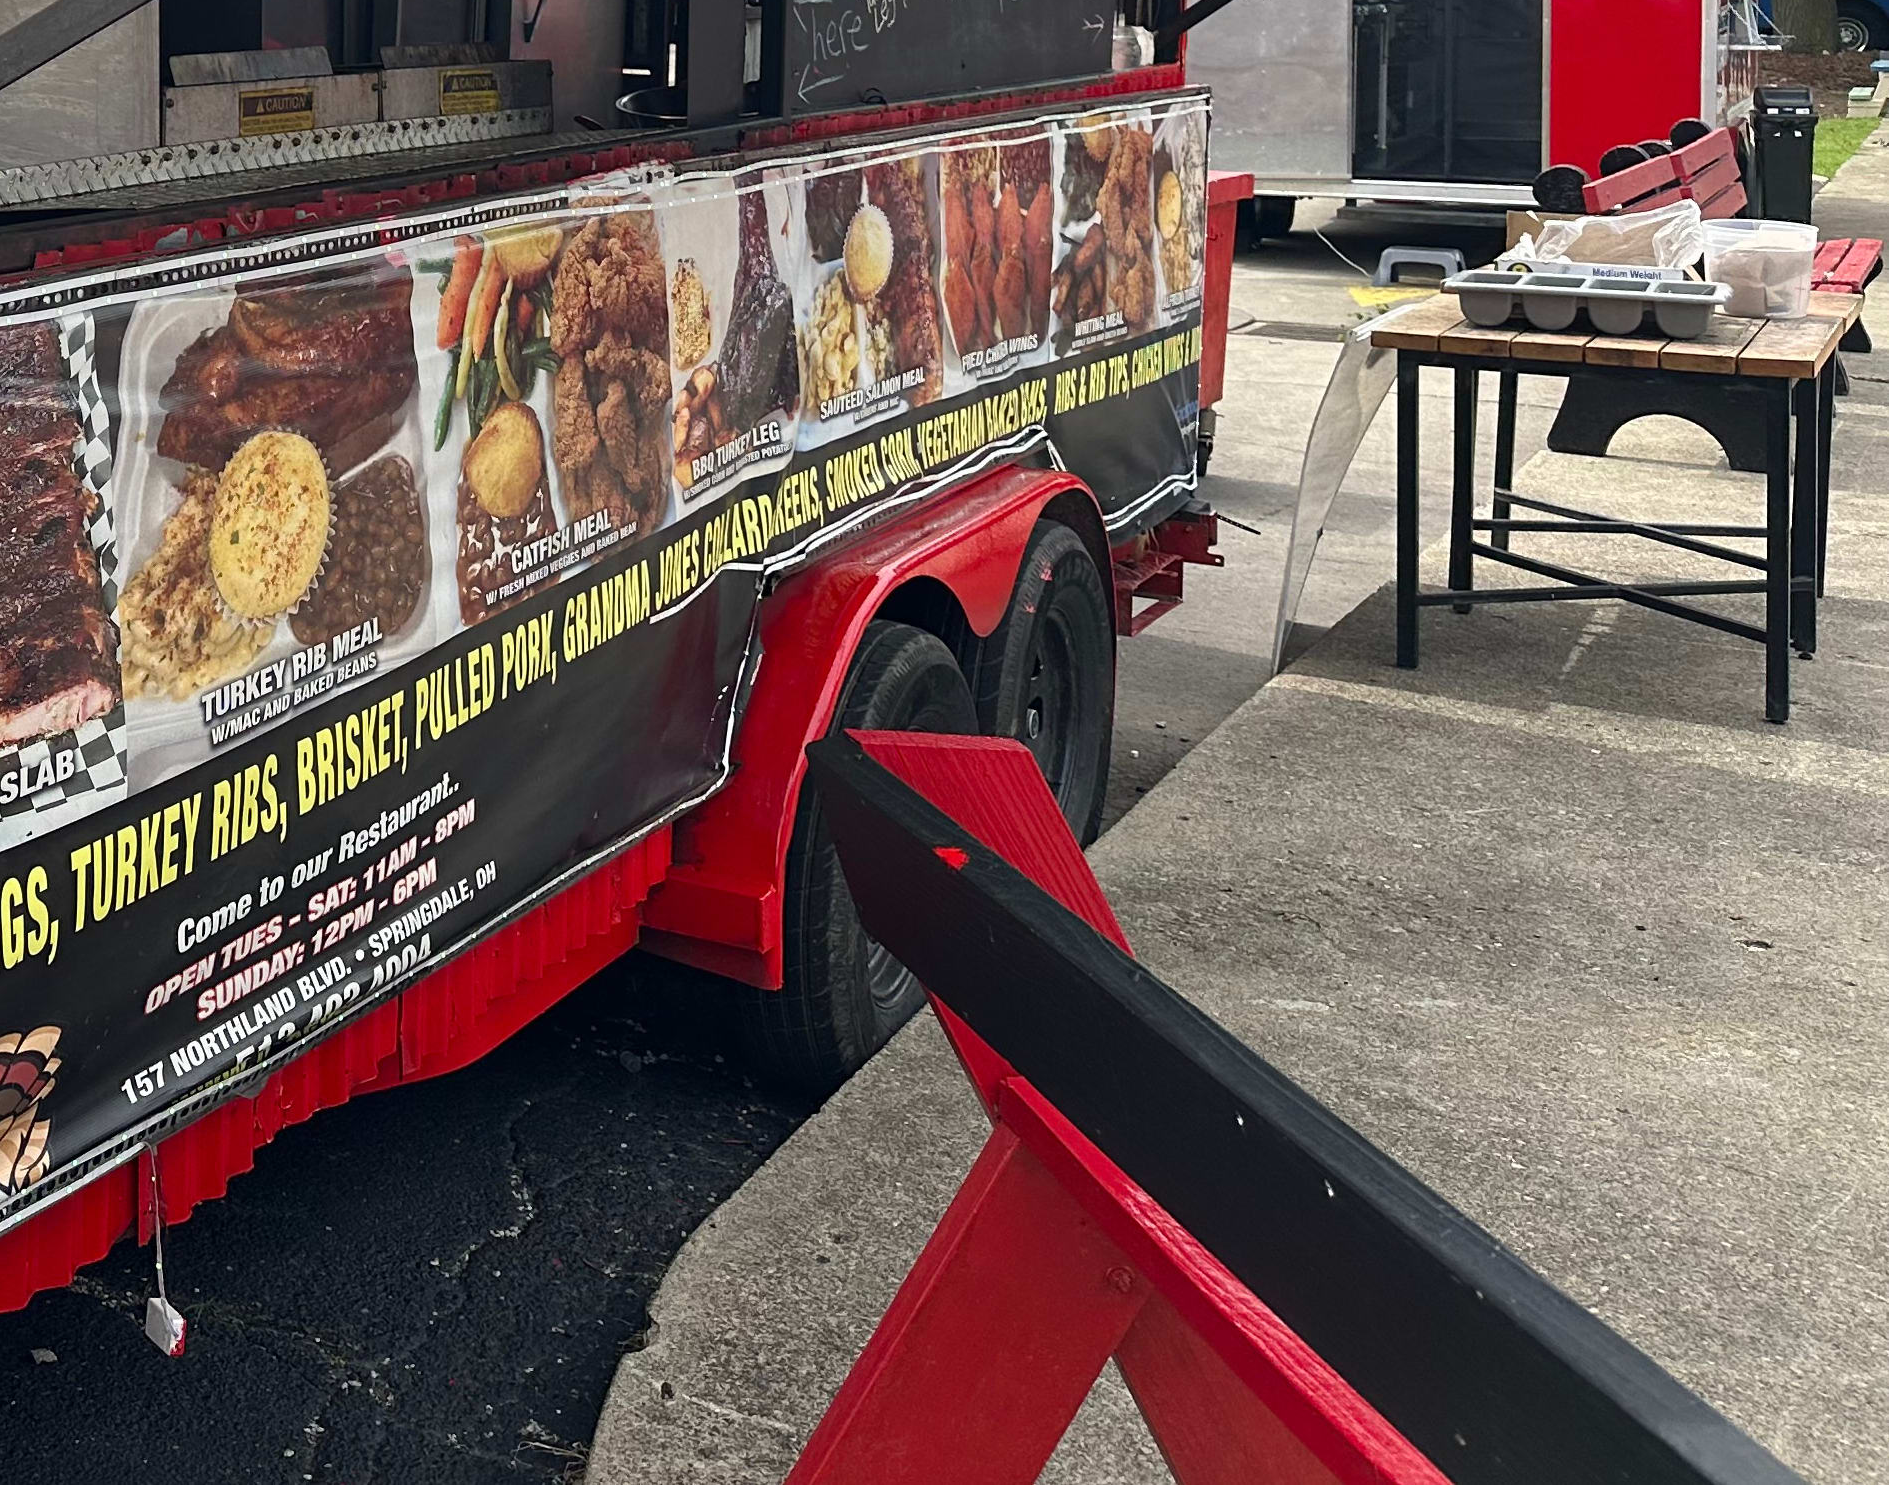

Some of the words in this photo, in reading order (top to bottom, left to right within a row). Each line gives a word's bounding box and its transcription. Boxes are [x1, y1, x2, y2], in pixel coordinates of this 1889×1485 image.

[812, 8, 870, 62] here
[266, 95, 306, 112] CAUTION
[460, 74, 493, 90] CAUTION
[1592, 268, 1628, 278] Medium
[1630, 270, 1662, 280] Weight
[1009, 334, 1038, 354] WINGS
[820, 389, 863, 420] SAUTEED
[865, 375, 901, 404] SALMON
[902, 366, 925, 389] MEAL
[692, 452, 714, 481] BBQ
[716, 430, 752, 467] TURKEY
[752, 421, 780, 447] LEG
[499, 577, 525, 600] FRESH
[525, 565, 549, 588] MIXED
[550, 550, 580, 576] VEGGIES
[580, 543, 596, 559] AND
[511, 526, 570, 574] CATFISH
[573, 508, 612, 545] MEAL
[71, 792, 202, 932] TURKEY
[210, 753, 289, 861] RIBS,
[296, 689, 409, 815] BRISKET,
[414, 642, 496, 751] PULLED
[500, 610, 558, 701] PORK,
[562, 559, 651, 663] GRANDMA
[654, 528, 701, 611] JONES
[703, 494, 773, 578] COLLARD
[825, 442, 886, 512] SMOKED
[916, 399, 986, 470] VEGETARIAN
[985, 388, 1020, 441] BAKED
[1054, 369, 1077, 415] RIBS
[1079, 366, 1087, 407] &
[1089, 361, 1106, 404] RIB
[1108, 352, 1130, 399] TIPS,
[201, 659, 288, 722] TURKEY
[290, 642, 327, 682] RIB
[332, 616, 383, 663] MEAL
[211, 709, 261, 745] W/MAC
[263, 694, 291, 722] AND
[294, 672, 334, 705] BAKED
[336, 651, 377, 684] BEANS
[144, 958, 216, 1015] OPEN
[220, 913, 284, 967] TUES
[306, 878, 359, 927] SAT:
[361, 836, 417, 892] 11AM
[434, 799, 476, 844] 8PM
[176, 893, 252, 955] Come
[259, 874, 285, 907] to
[290, 852, 334, 891] our
[197, 942, 306, 1021] SUNDAY:
[311, 897, 374, 957] 12PM
[391, 858, 439, 909] 6PM
[121, 1059, 165, 1105] 157
[169, 986, 296, 1078] NORTHLAND
[297, 955, 352, 1005] BLVD.
[367, 880, 474, 959] SPRINGDALE,
[474, 860, 497, 891] OH
